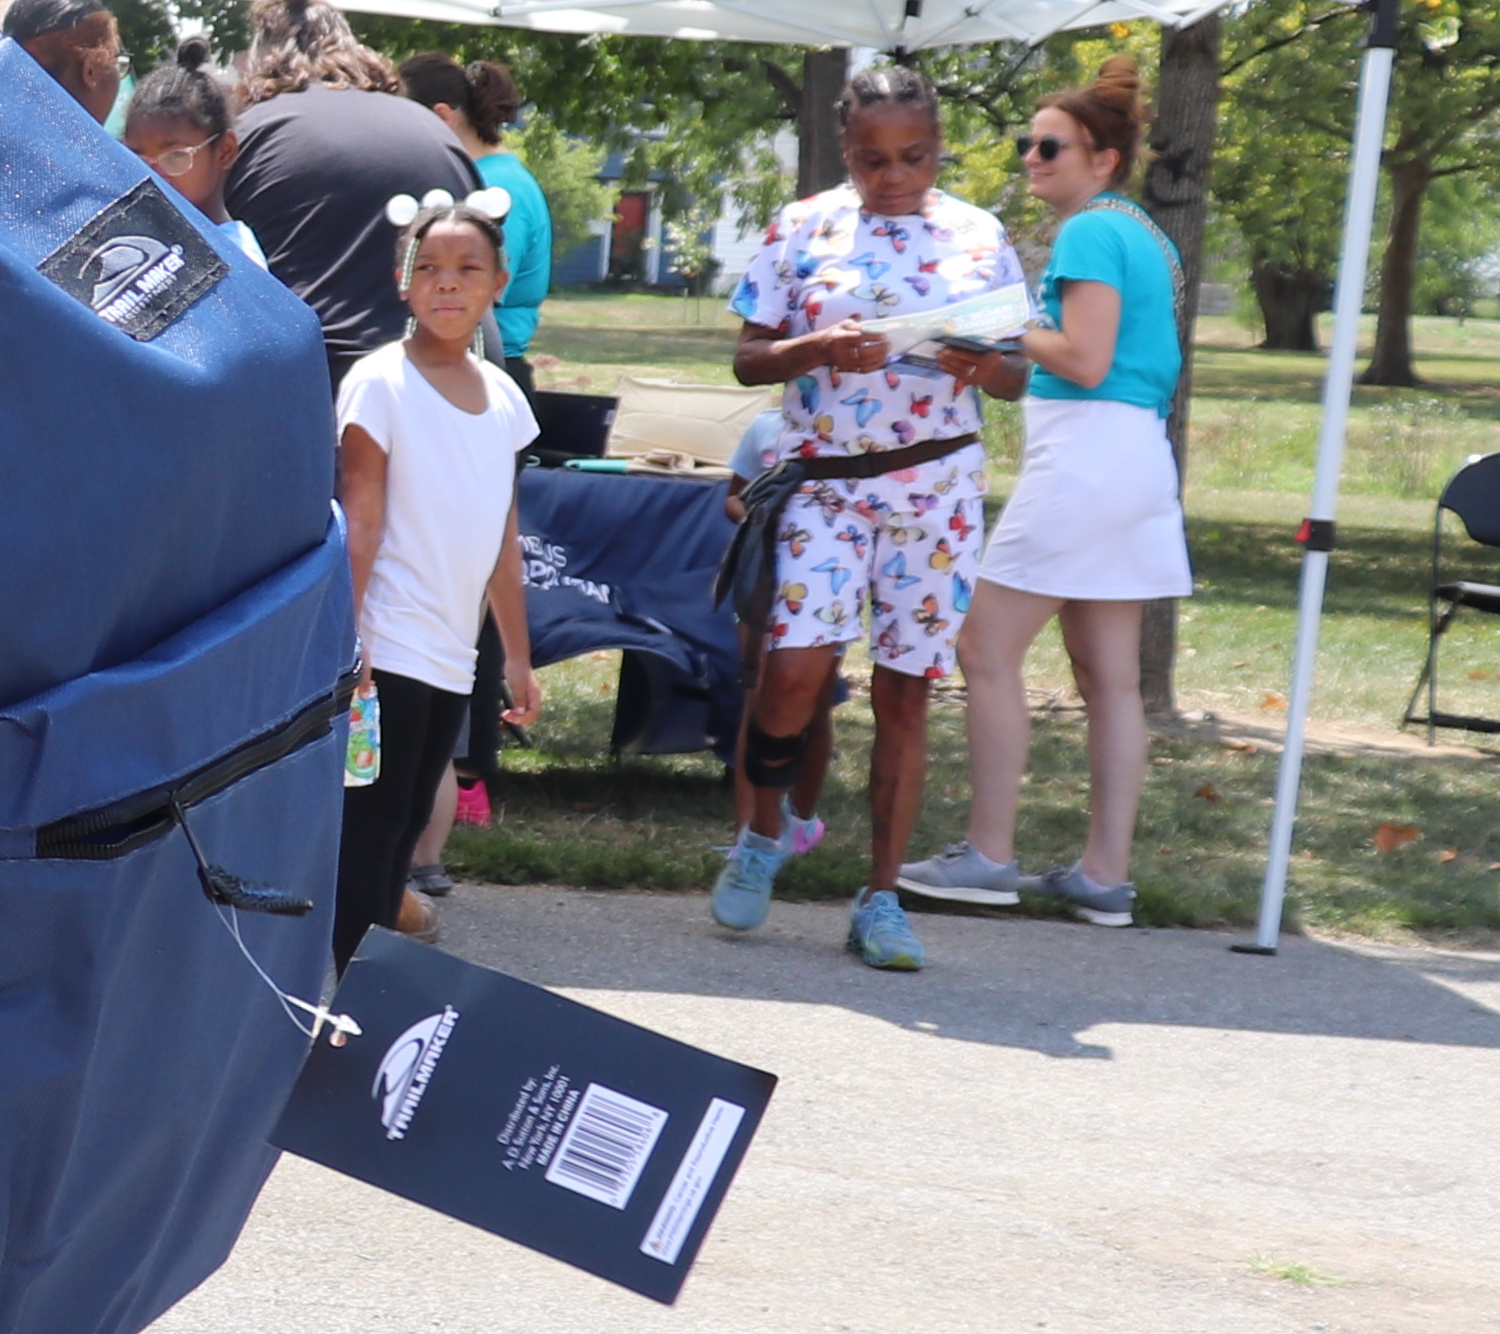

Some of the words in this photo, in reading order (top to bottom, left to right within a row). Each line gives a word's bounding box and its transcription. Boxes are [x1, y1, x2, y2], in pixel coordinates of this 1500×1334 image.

[98, 289, 146, 322] TRAIL
[136, 253, 185, 294] MAKER
[497, 1091, 531, 1146] Distributed
[557, 1089, 581, 1122] CHINA
[513, 1115, 536, 1147] Sutton
[517, 1146, 538, 1171] New
[540, 1103, 557, 1123] NY
[549, 1075, 571, 1104] 10001
[550, 1121, 565, 1135] IN
[535, 1134, 559, 1167] MADE
